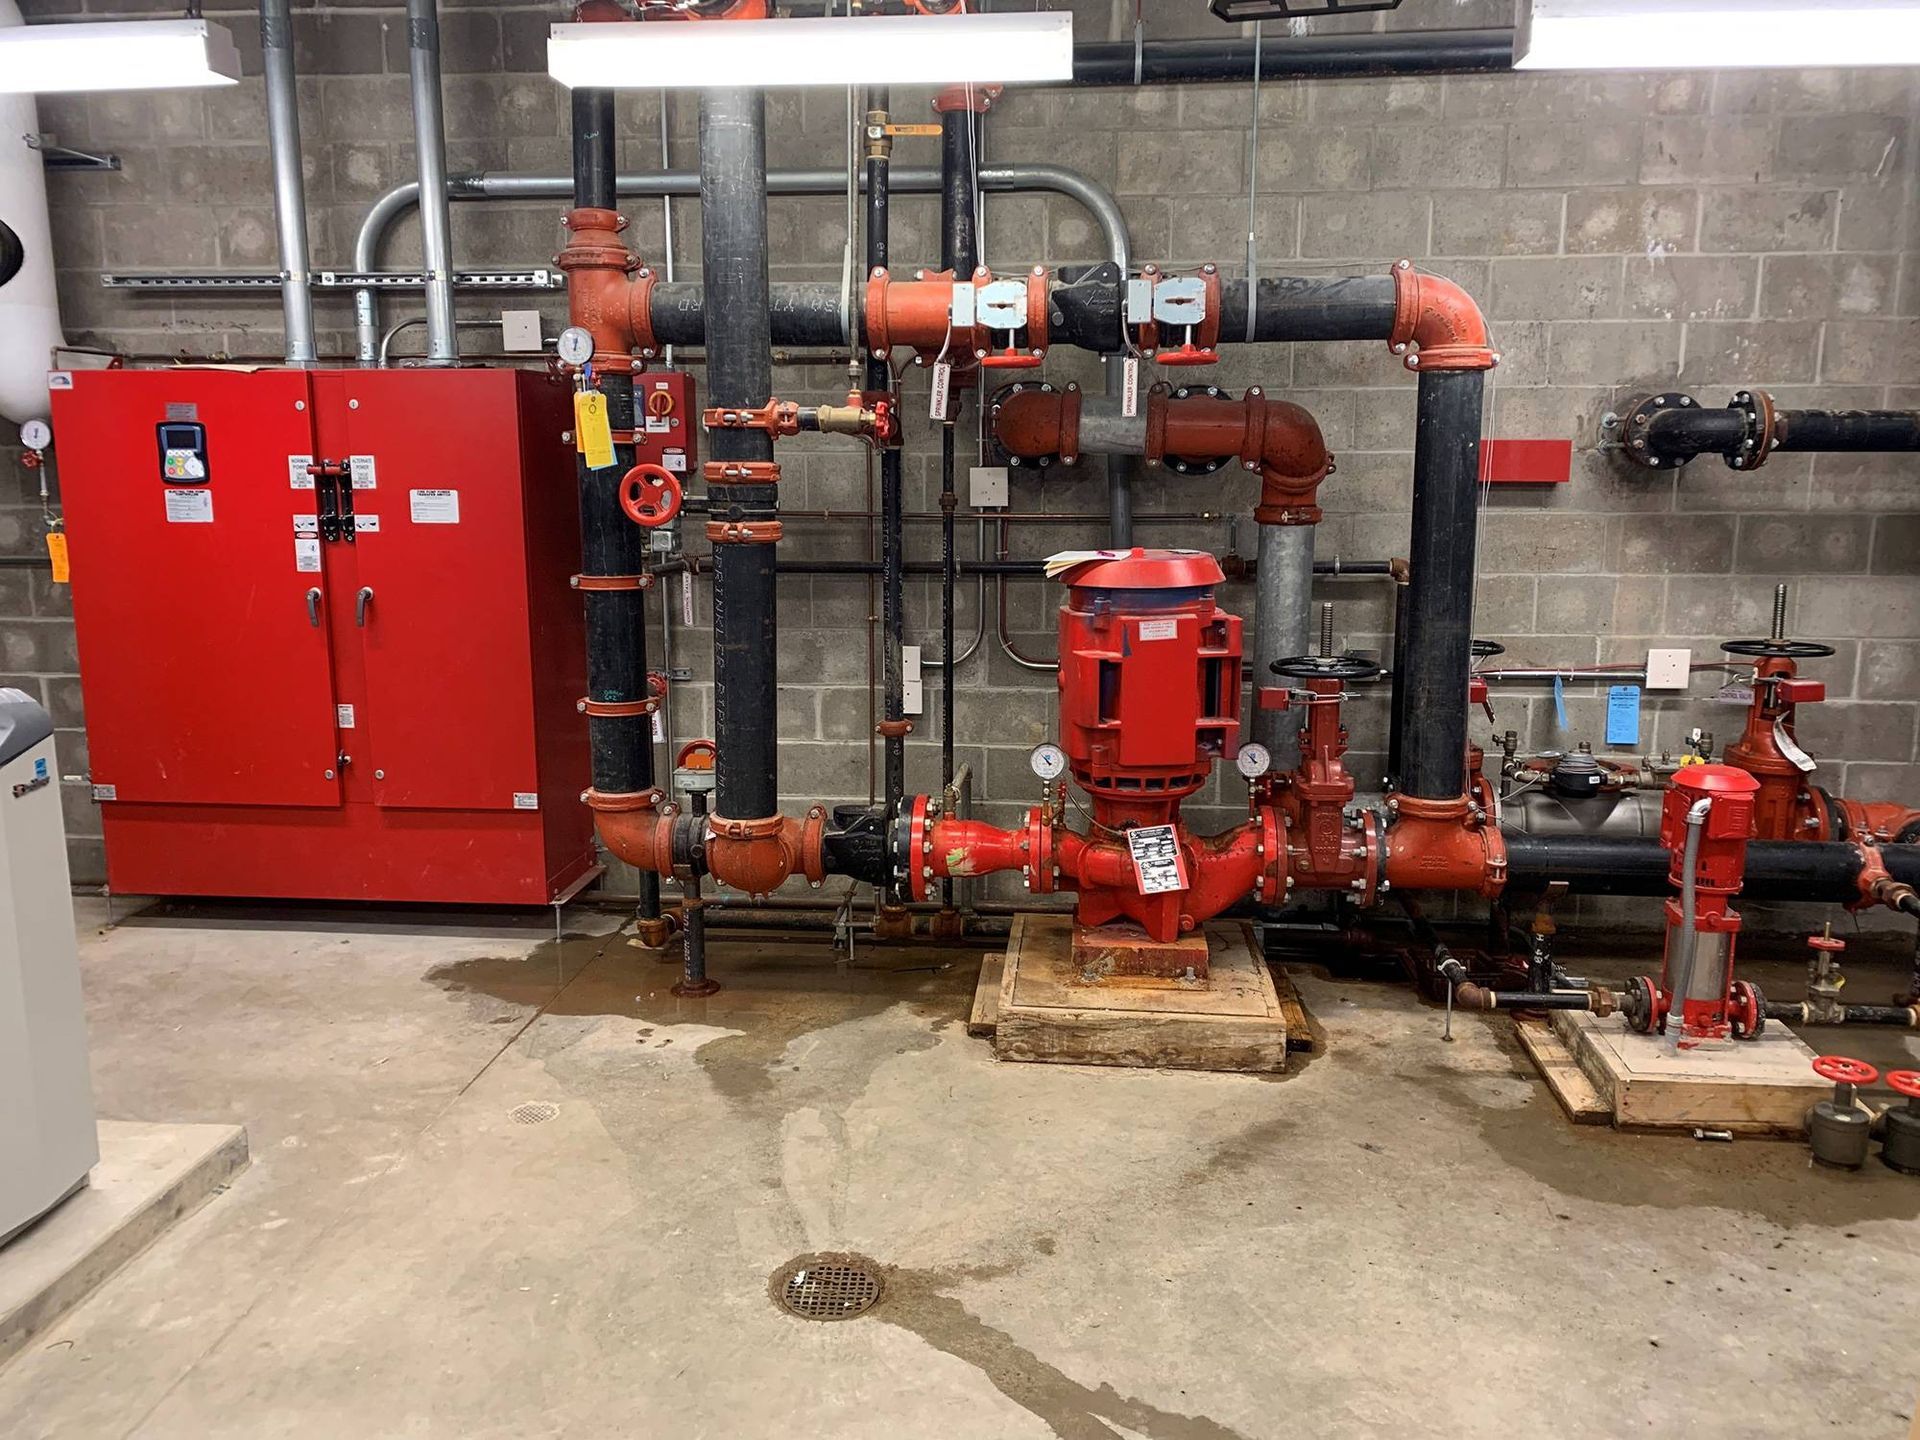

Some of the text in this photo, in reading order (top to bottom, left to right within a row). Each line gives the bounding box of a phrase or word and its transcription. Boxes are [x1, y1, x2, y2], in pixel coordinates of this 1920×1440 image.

[934, 365, 946, 417] SPRINKLER CONTROL
[1126, 361, 1135, 414] SPRINKLER CONTROL
[714, 544, 725, 669] SPRINKLER
